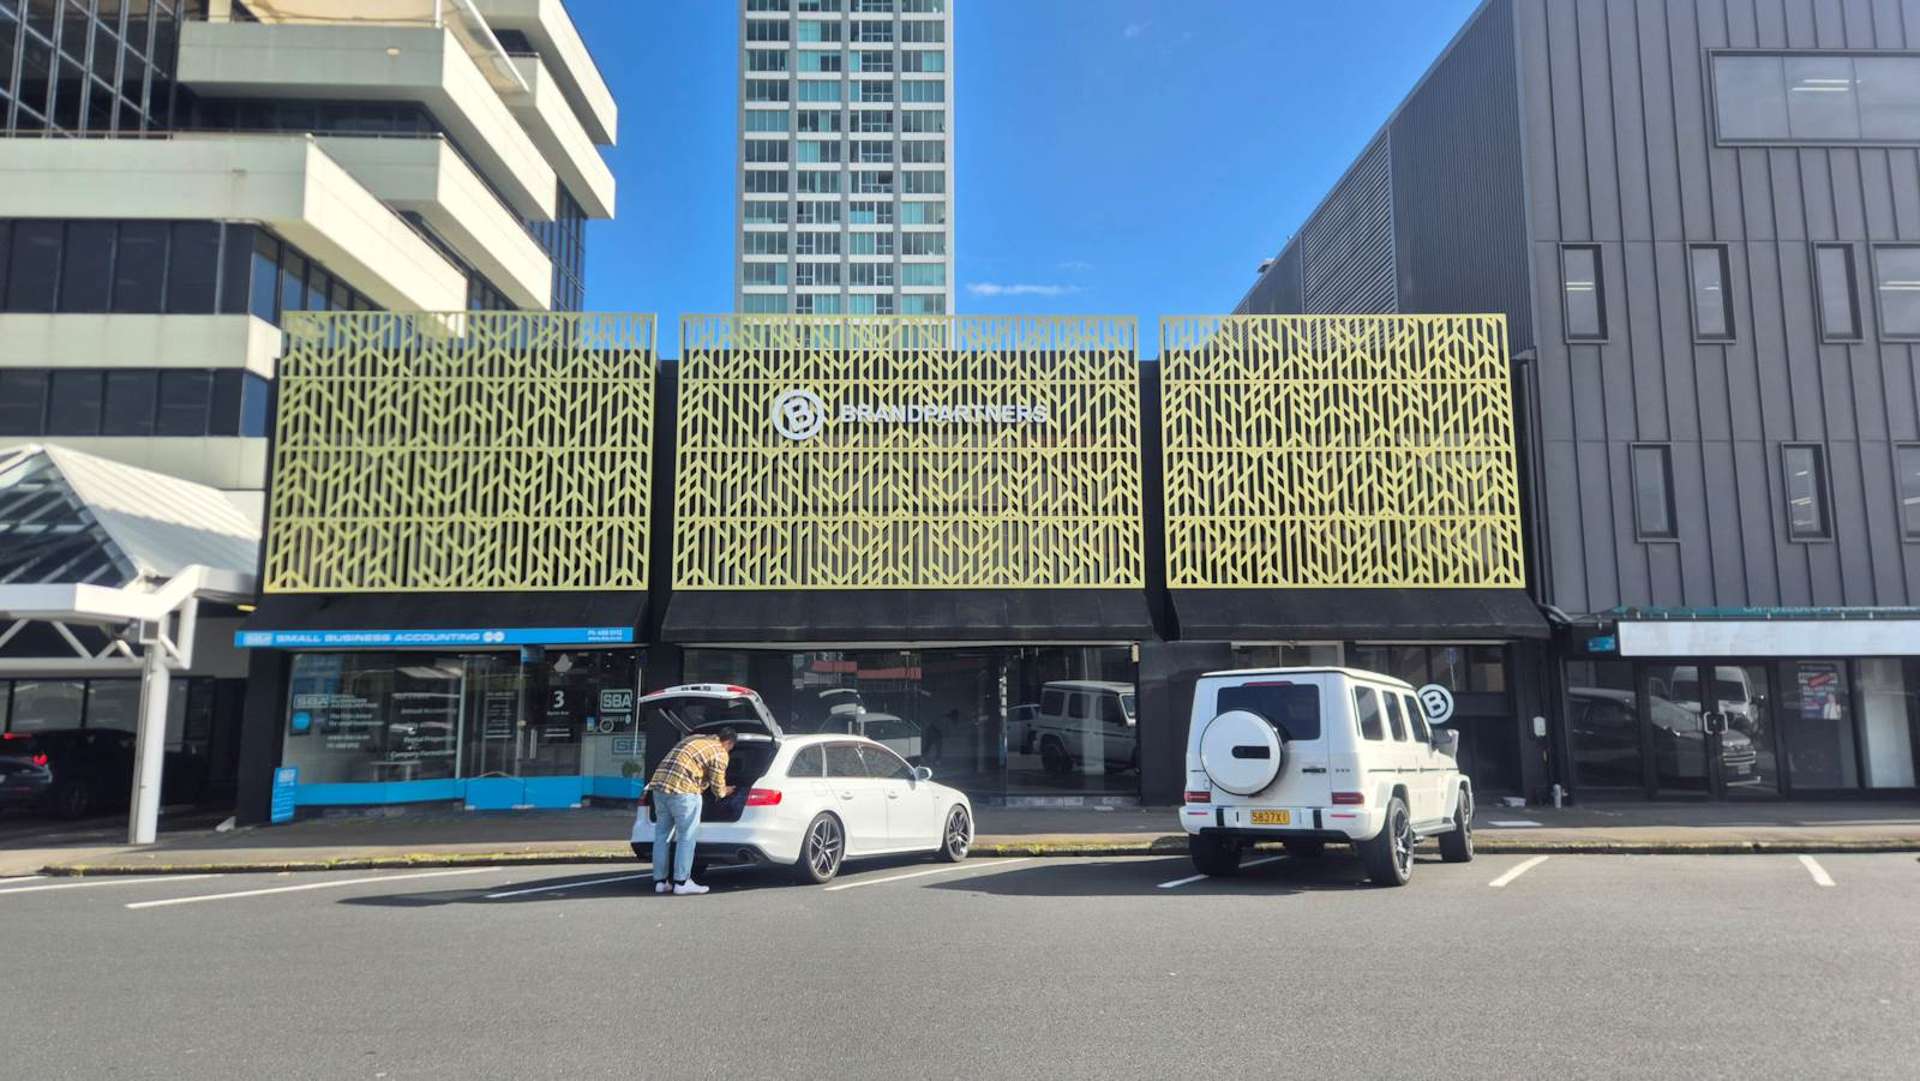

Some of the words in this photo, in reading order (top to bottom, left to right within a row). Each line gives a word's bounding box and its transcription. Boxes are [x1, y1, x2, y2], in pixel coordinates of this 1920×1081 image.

[841, 403, 1049, 424] BRANDPARTNERS
[276, 634, 322, 643] SMALL
[324, 633, 391, 642] BUSINESS
[394, 632, 481, 641] ACCOUNTING
[553, 690, 565, 708] 3
[602, 693, 632, 708] SBA
